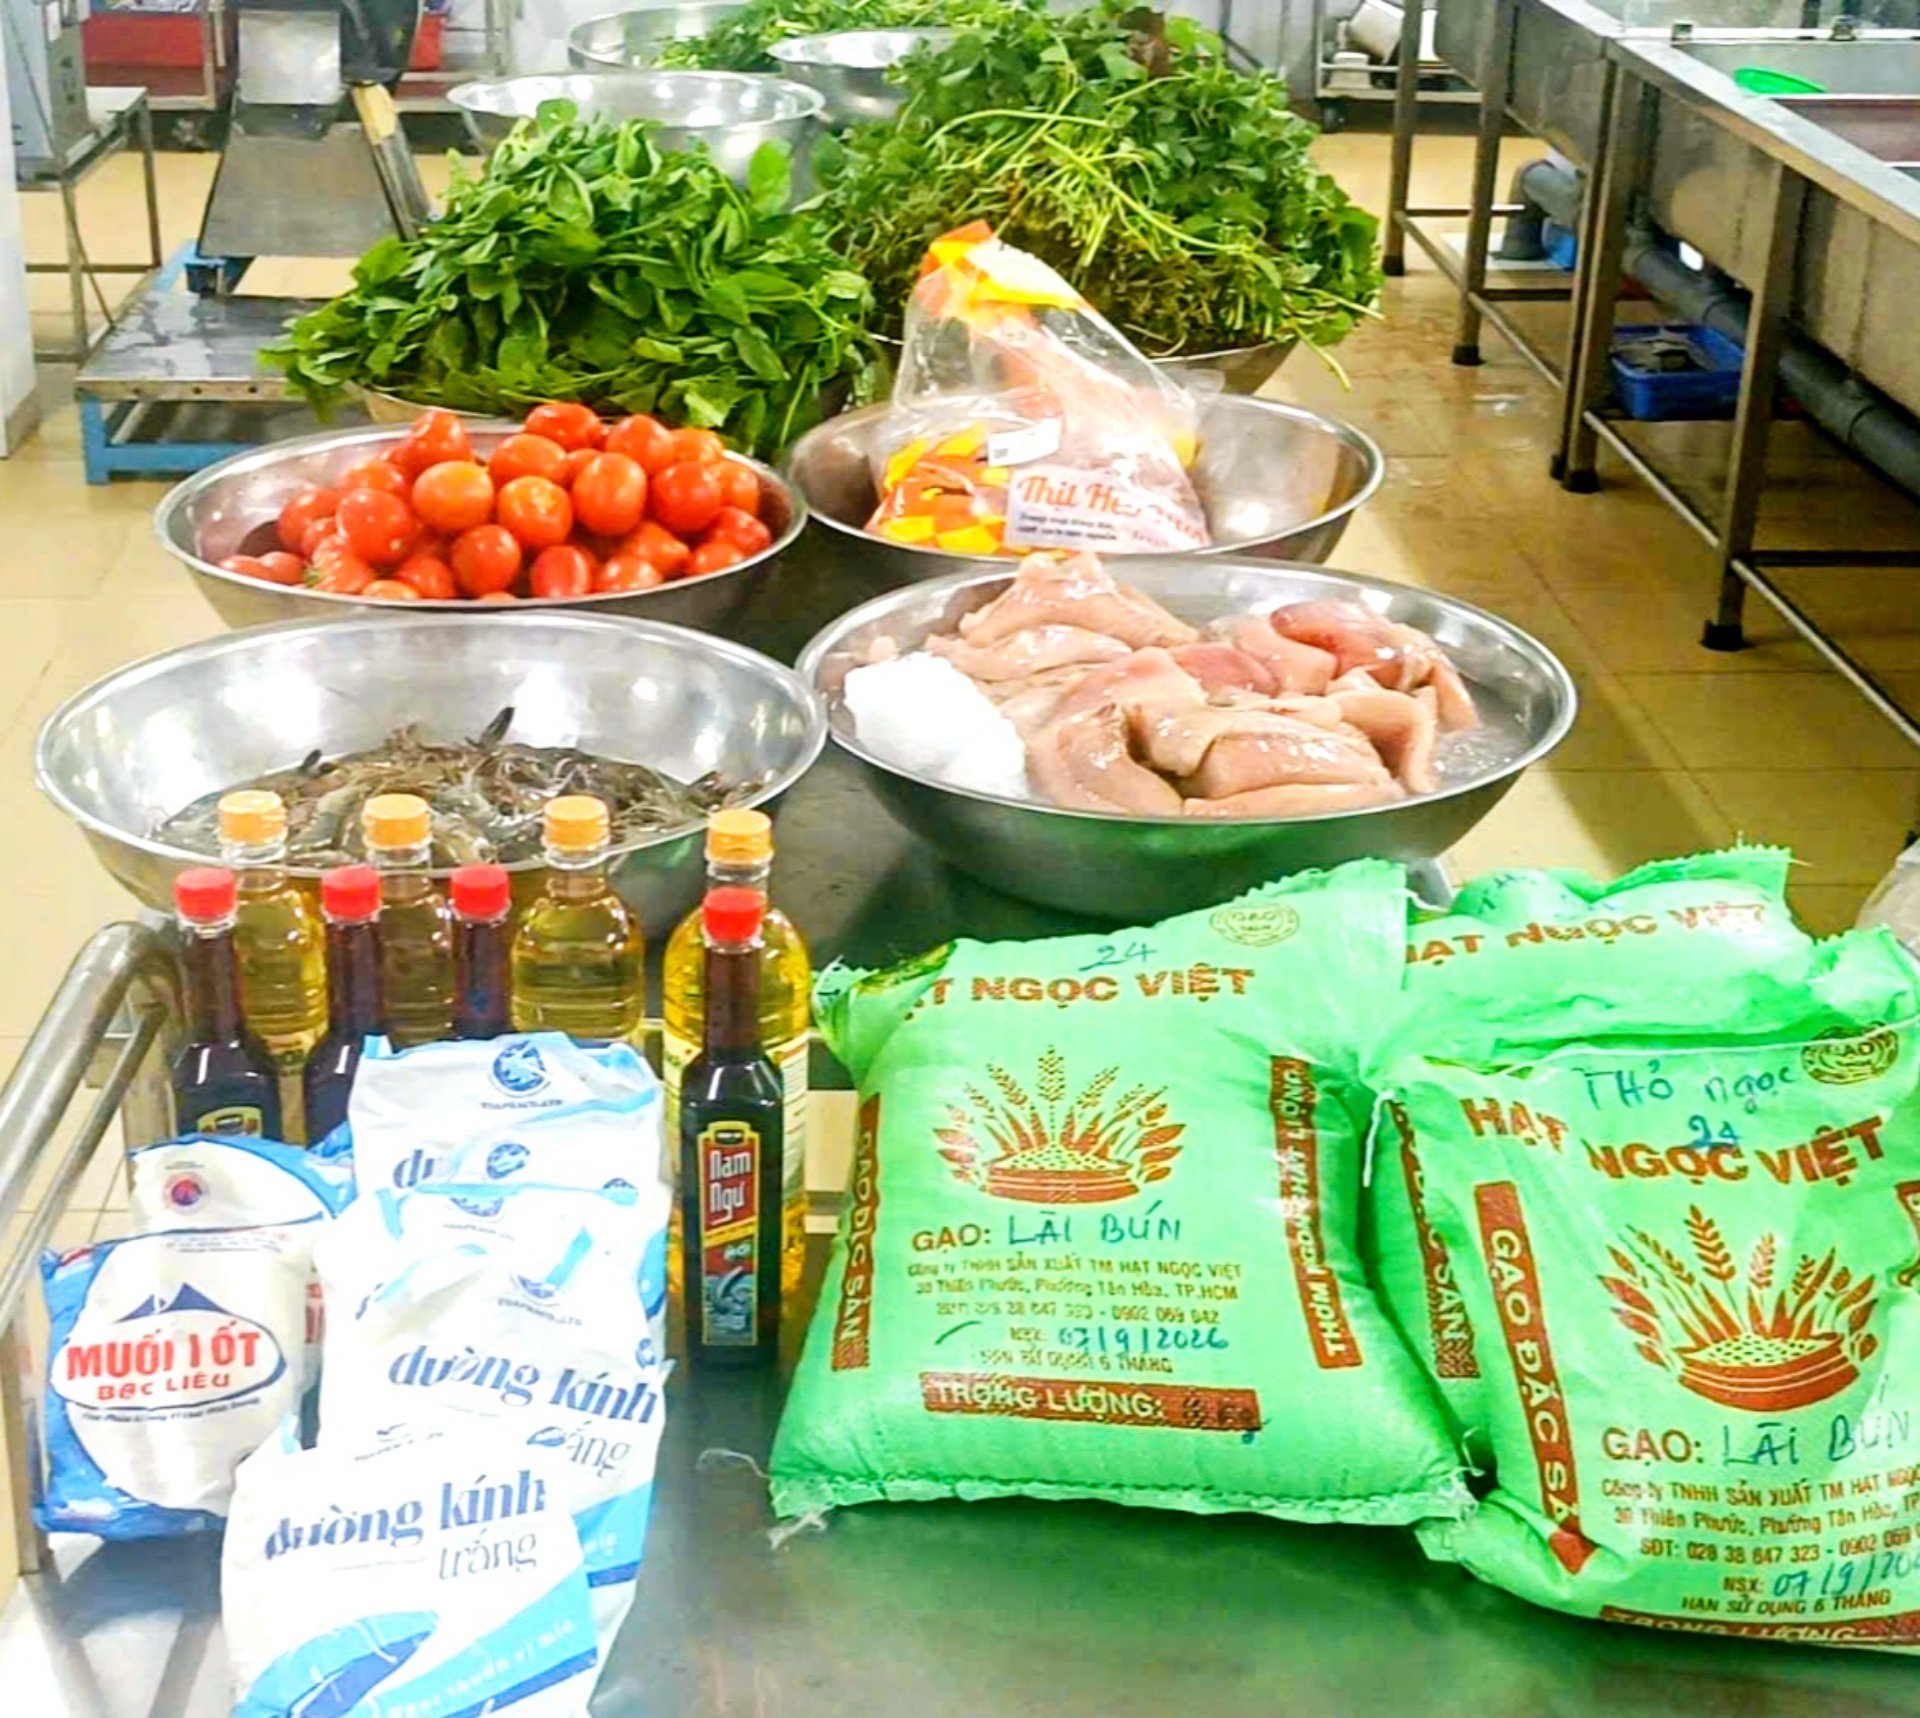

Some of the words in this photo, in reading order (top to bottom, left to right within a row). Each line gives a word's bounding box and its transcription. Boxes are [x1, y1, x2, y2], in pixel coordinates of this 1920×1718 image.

[972, 976, 1119, 1009] NGỌC
[1135, 962, 1254, 1002] VIỆT
[1461, 1098, 1569, 1153] HẠT
[1581, 1138, 1749, 1185] NGỌC
[1756, 1116, 1885, 1186] VIỆT
[911, 1223, 991, 1253] GẠO:
[1100, 1200, 1181, 1244] BÚN
[67, 1327, 174, 1380] MUỐI
[1490, 1228, 1533, 1327] GẠO
[1515, 1338, 1561, 1444] ĐẶC
[1543, 1460, 1580, 1523] SẢ
[549, 1367, 658, 1424] kính
[1046, 1384, 1164, 1421] LƯỢNG:
[1602, 1426, 1704, 1467] GẠO:
[439, 1469, 547, 1530] kính
[1725, 1477, 1764, 1507] SẢN
[1820, 1481, 1844, 1501] TM
[1790, 1543, 1821, 1563] 323
